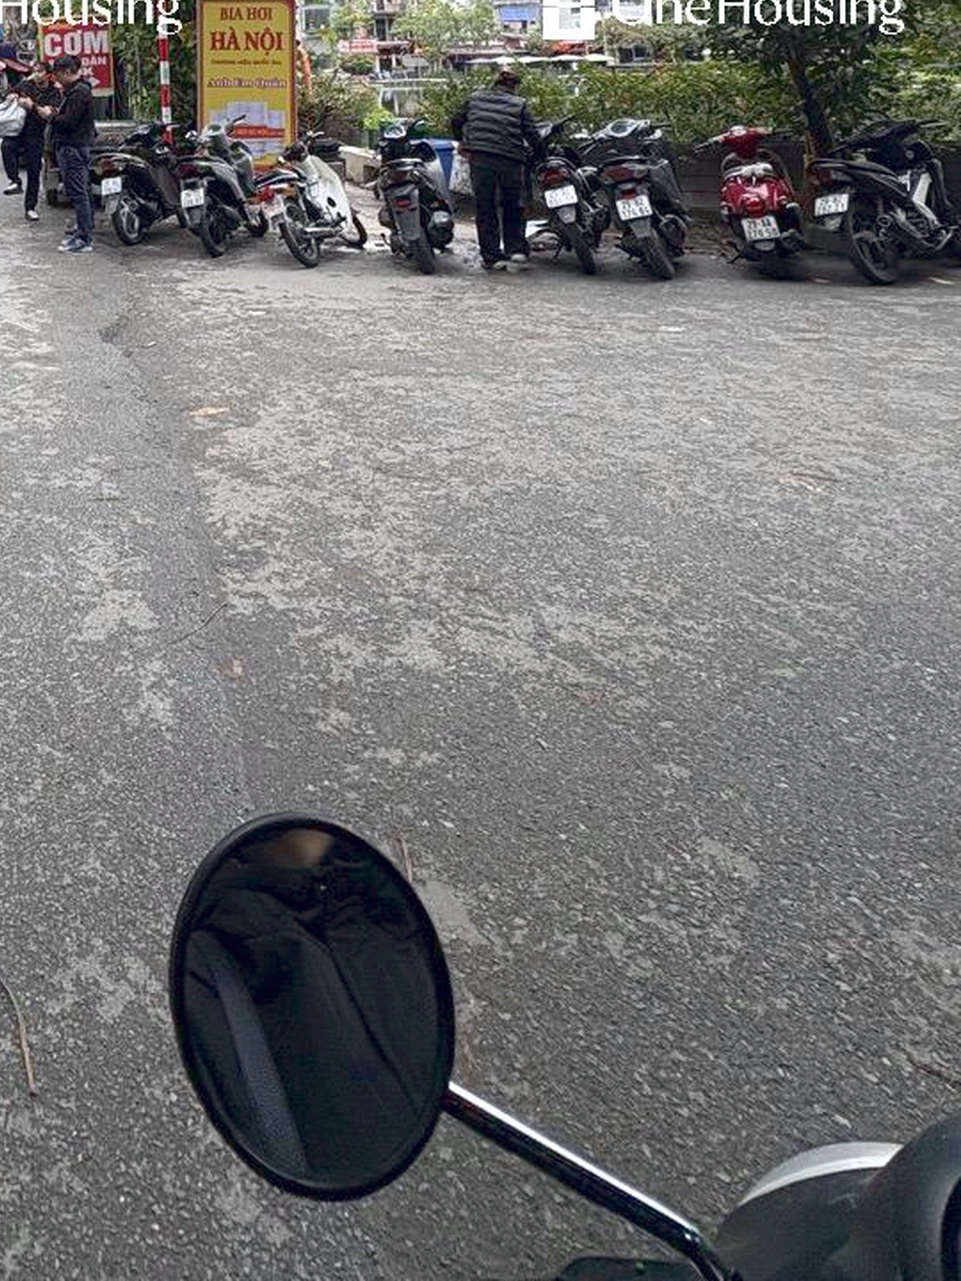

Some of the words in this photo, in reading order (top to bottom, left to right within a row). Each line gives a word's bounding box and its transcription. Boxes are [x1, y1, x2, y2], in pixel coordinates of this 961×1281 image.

[220, 7, 243, 21] BIA
[209, 27, 241, 52] HÀ
[244, 26, 284, 56] NỘI
